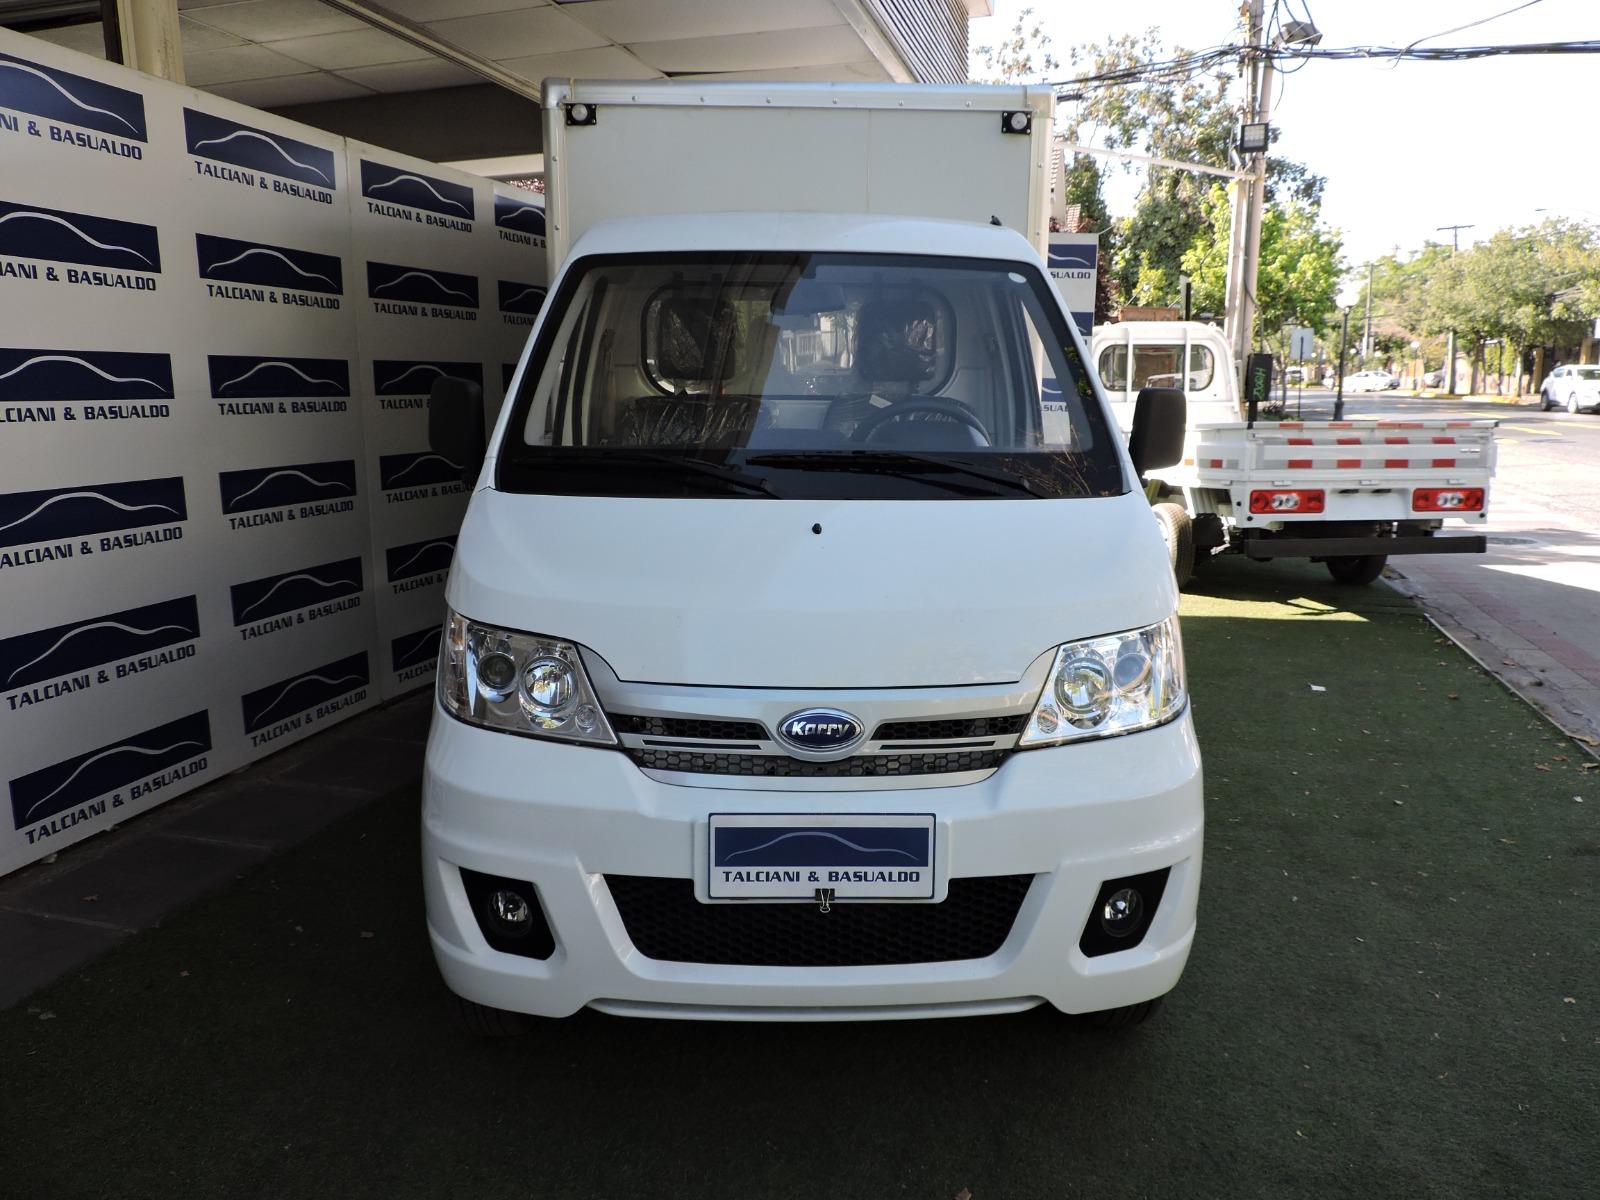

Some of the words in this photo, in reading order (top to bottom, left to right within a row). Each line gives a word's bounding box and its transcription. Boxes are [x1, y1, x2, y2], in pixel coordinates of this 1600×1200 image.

[28, 120, 41, 137] &
[50, 125, 142, 160] BASUALDO
[195, 160, 254, 187] TALCIANI
[259, 176, 268, 190] &
[273, 179, 332, 204] BASUALDO
[367, 202, 412, 221] TALCIANI
[415, 213, 422, 223] &
[426, 215, 472, 233] BASUALDO
[499, 230, 531, 246] TALCIANI
[46, 266, 60, 282] &
[67, 268, 156, 291] BASUALDO
[206, 284, 264, 302] TALCIANI
[269, 291, 278, 303] &
[282, 292, 340, 310] BASUALDO
[373, 302, 418, 316] TALCIANI
[421, 307, 428, 317] &
[431, 308, 477, 321] BASUALDO
[63, 407, 76, 421] &
[84, 404, 170, 420] BASUALDO
[218, 402, 274, 416] TALCIANI
[278, 403, 287, 414] &
[291, 401, 347, 413] BASUALDO
[380, 398, 423, 410] TALCIANI
[386, 488, 428, 504] TALCIANI
[431, 487, 438, 497] &
[229, 511, 284, 530] TALCIANI
[288, 509, 296, 521] &
[300, 500, 354, 519] BASUALDO
[80, 541, 93, 555] &
[100, 526, 183, 552] BASUALDO
[240, 615, 293, 641] TALCIANI
[296, 613, 304, 624] &
[308, 596, 361, 621] BASUALDO
[6, 674, 91, 711] TALCIANI
[97, 669, 110, 684] &
[116, 644, 196, 679] BASUALDO
[250, 717, 301, 748] TALCIANI
[305, 711, 313, 724] &
[316, 689, 367, 720] BASUALDO
[25, 801, 106, 845] TALCIANI
[112, 793, 124, 809] &
[130, 757, 208, 799] BASUALDO
[722, 871, 800, 883] TALCIANI
[807, 871, 820, 883] &
[828, 871, 920, 883] BASUALDO
